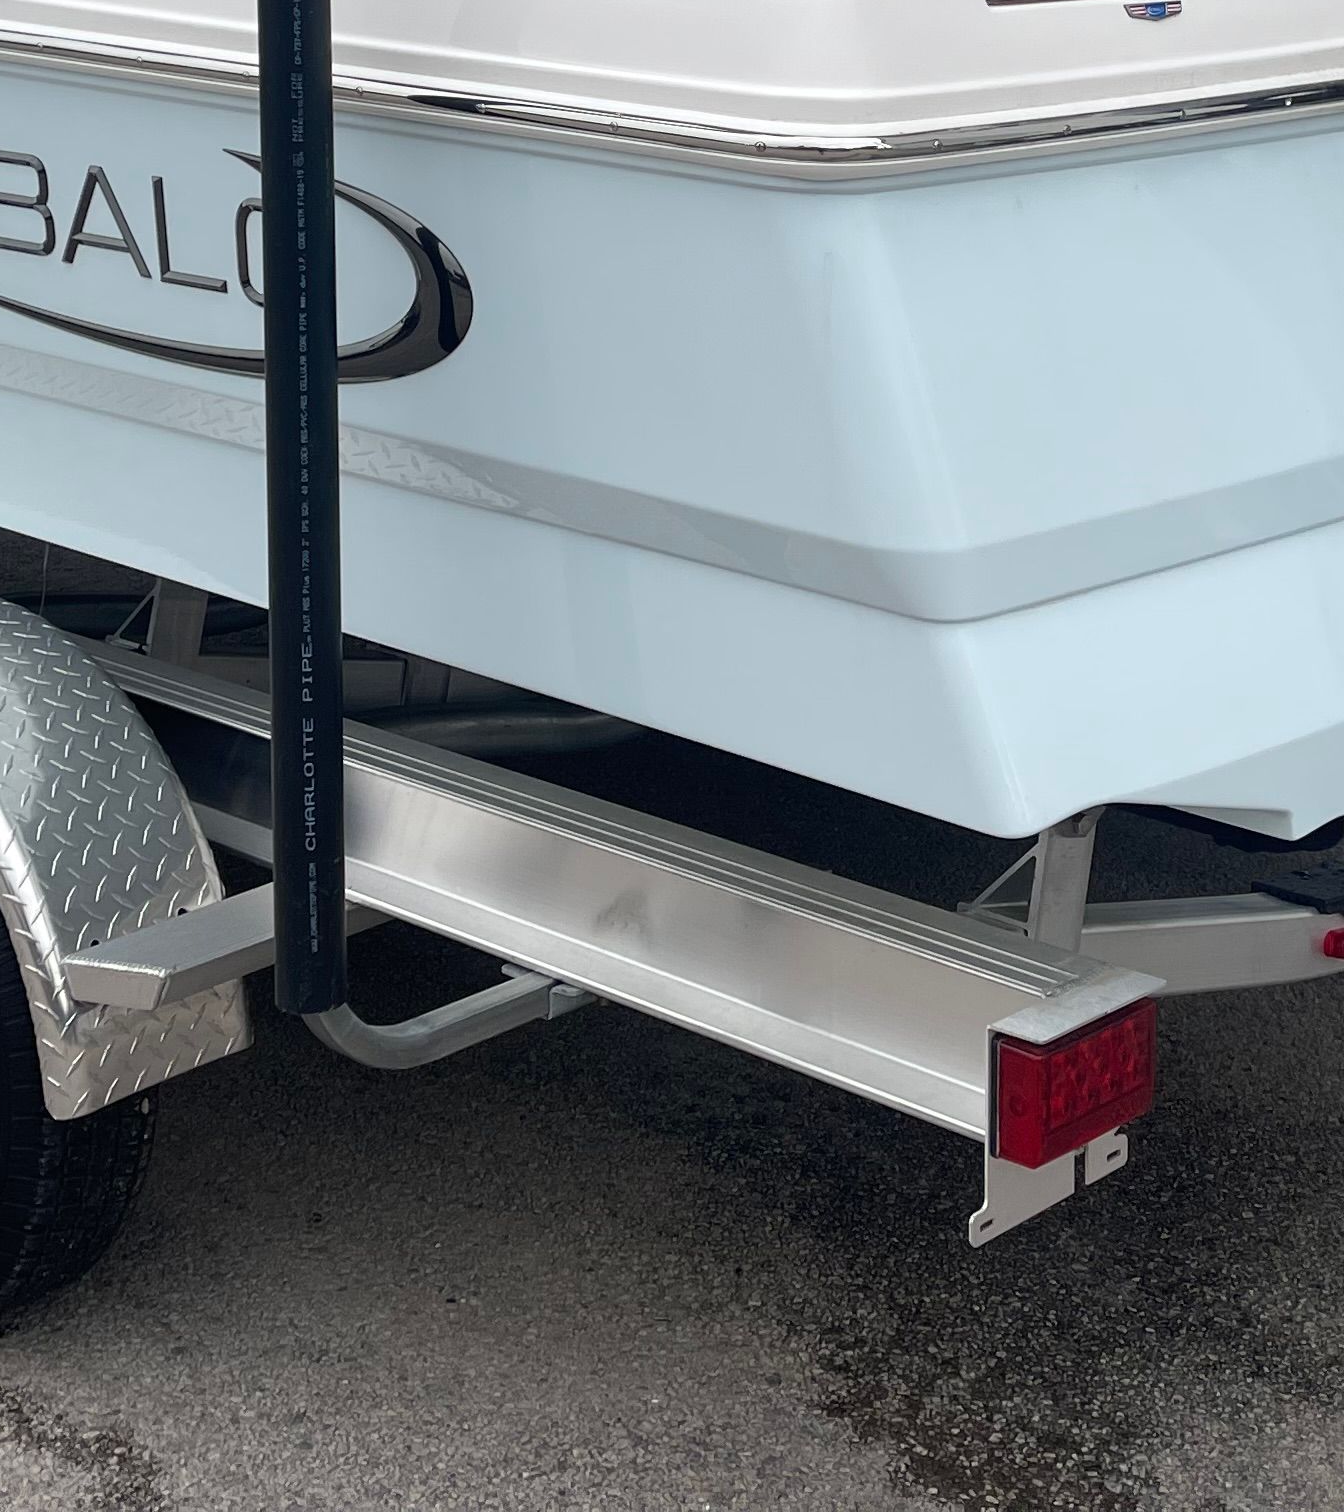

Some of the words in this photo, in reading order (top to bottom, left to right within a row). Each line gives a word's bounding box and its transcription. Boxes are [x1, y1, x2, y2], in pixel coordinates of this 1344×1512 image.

[298, 231, 306, 250] CODE
[299, 313, 307, 331] PIPE
[301, 642, 313, 702] PIPE
[302, 717, 316, 851] CHARLOTTE
